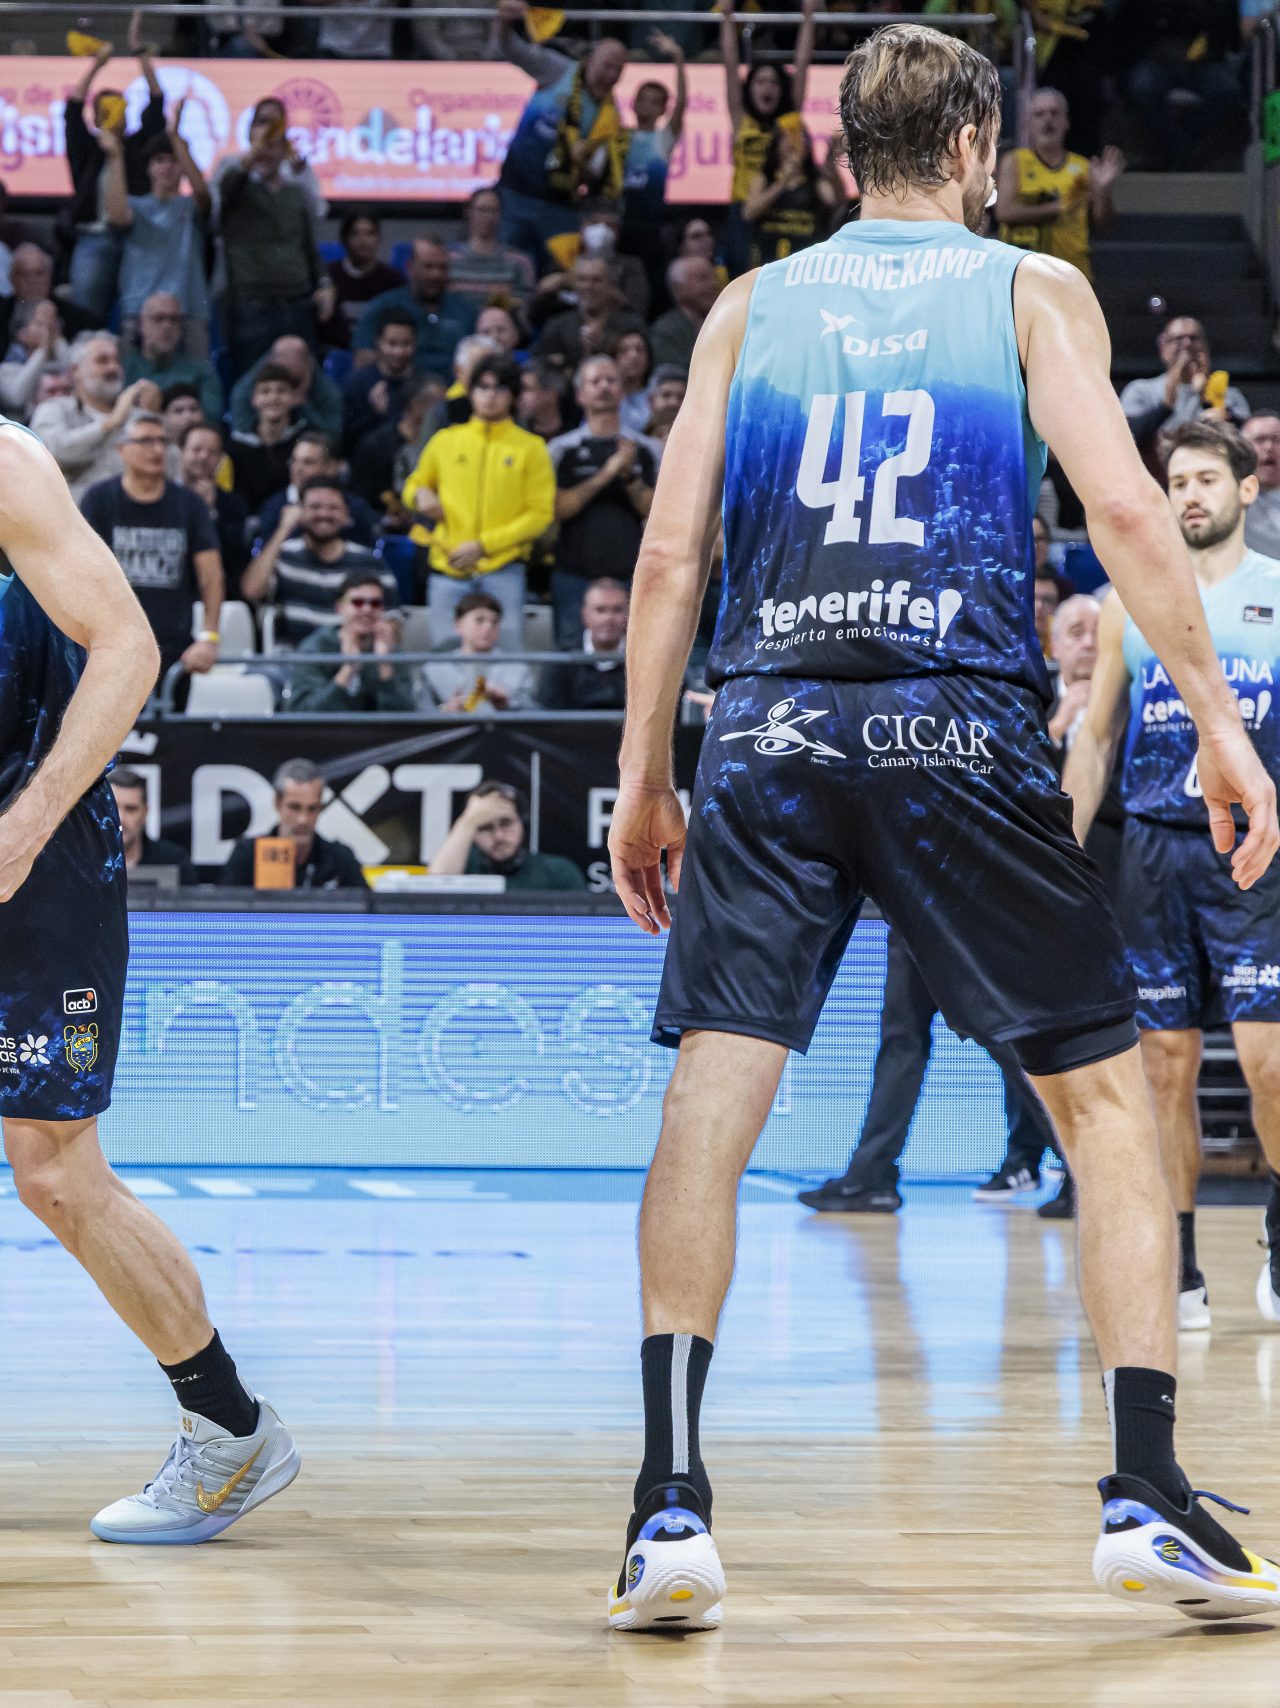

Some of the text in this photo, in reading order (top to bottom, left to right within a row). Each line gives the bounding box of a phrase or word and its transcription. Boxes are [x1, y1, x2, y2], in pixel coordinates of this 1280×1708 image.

[784, 248, 988, 291] DOORNEKAMP
[796, 388, 936, 547] 42
[754, 626, 931, 651] despierta emociones
[862, 715, 994, 759] CICAR
[867, 754, 919, 769] Canary
[970, 760, 994, 774] Car
[68, 998, 91, 1011] acb
